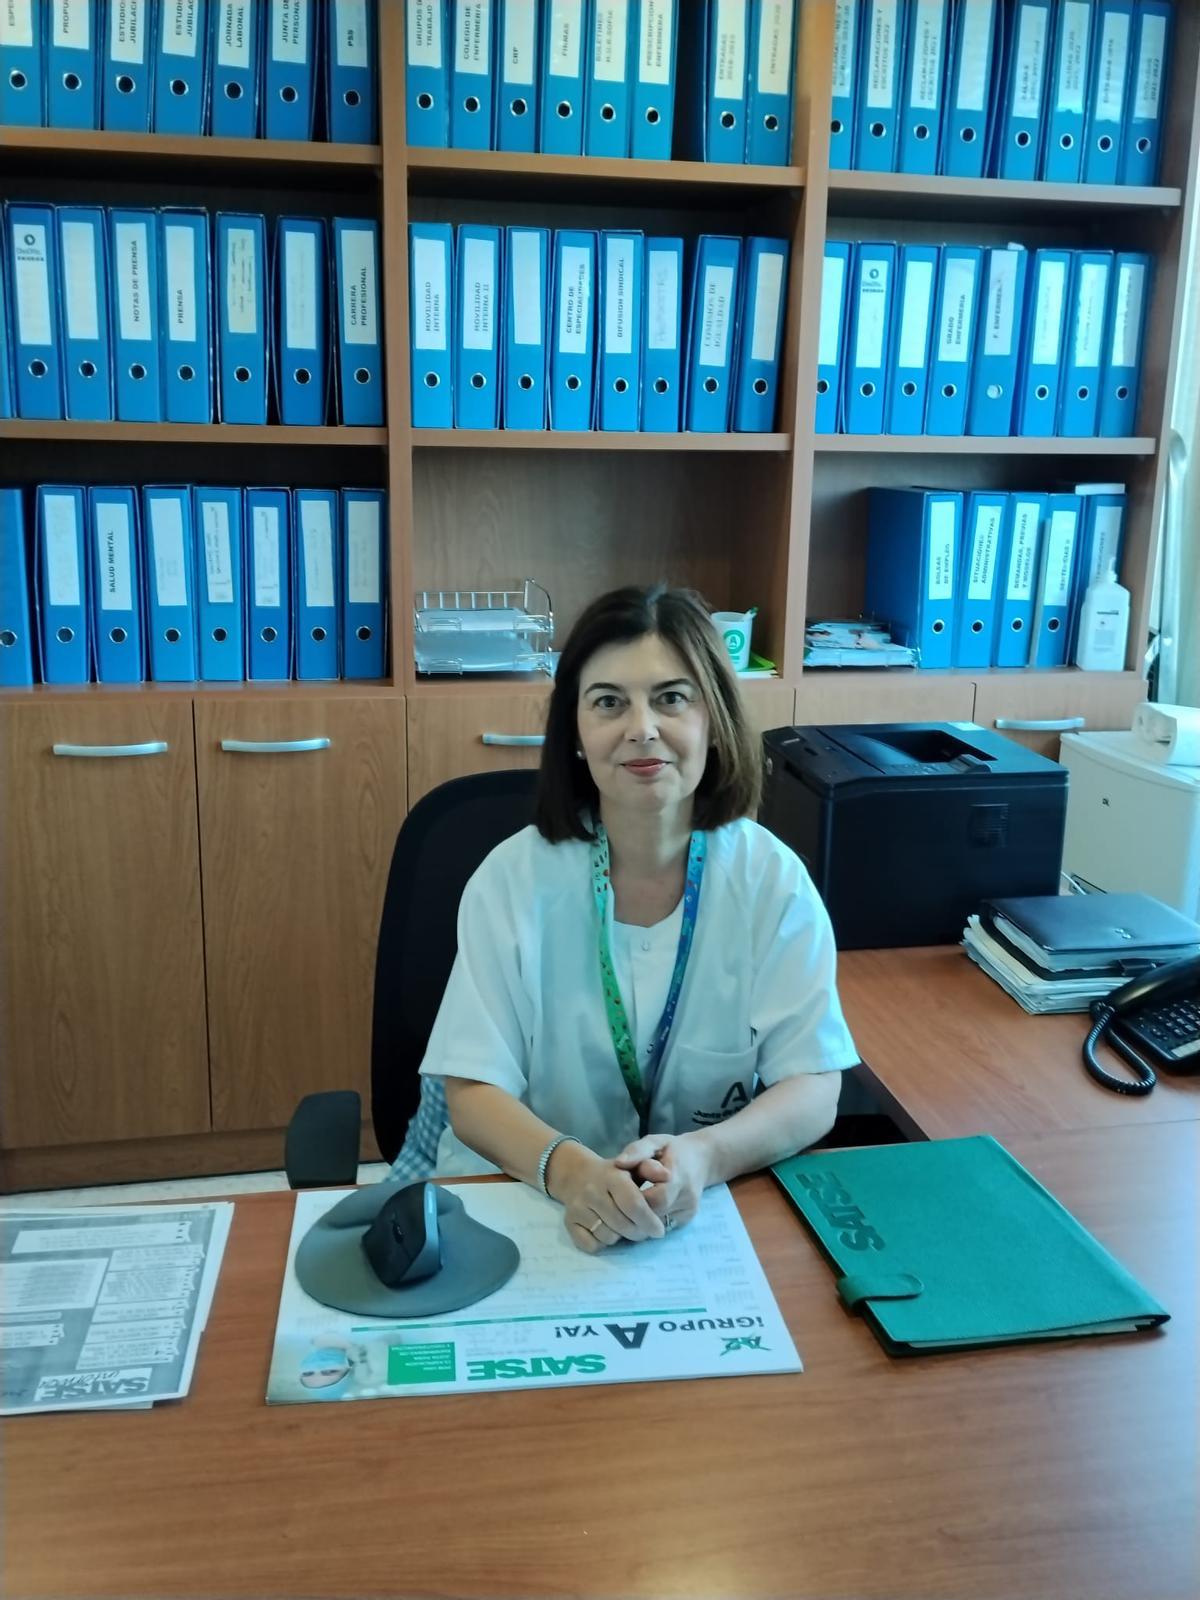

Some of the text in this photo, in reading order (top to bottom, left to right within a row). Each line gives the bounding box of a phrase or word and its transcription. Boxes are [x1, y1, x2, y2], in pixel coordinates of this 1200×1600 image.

[225, 3, 233, 47] JORNADA
[236, 6, 245, 48] LABORAL
[282, 12, 290, 43] JUNTA
[463, 5, 471, 60] COLEGIO DE
[872, 17, 882, 89] RECLAMACIONES
[130, 240, 139, 322] NOTAS DE PRENSA
[350, 284, 358, 326] CARRERA
[360, 266, 368, 326] PROFESIONAL
[616, 257, 625, 338] DIFUSION SINDICAL
[176, 289, 184, 324] PRENSA
[424, 281, 432, 332] MOVILIDAD
[566, 286, 575, 334] CENTRO DE
[946, 316, 955, 345] GRADO
[954, 294, 966, 345] ENFERMERIA
[106, 530, 116, 593] SALUD MENTAL
[981, 517, 995, 585] ADMINISTRATIVAS
[795, 1171, 886, 1252] SATSE
[554, 1325, 600, 1338] YA!
[603, 1322, 649, 1350] A
[41, 1377, 148, 1400] SATSE
[466, 1354, 606, 1381] SATSE
